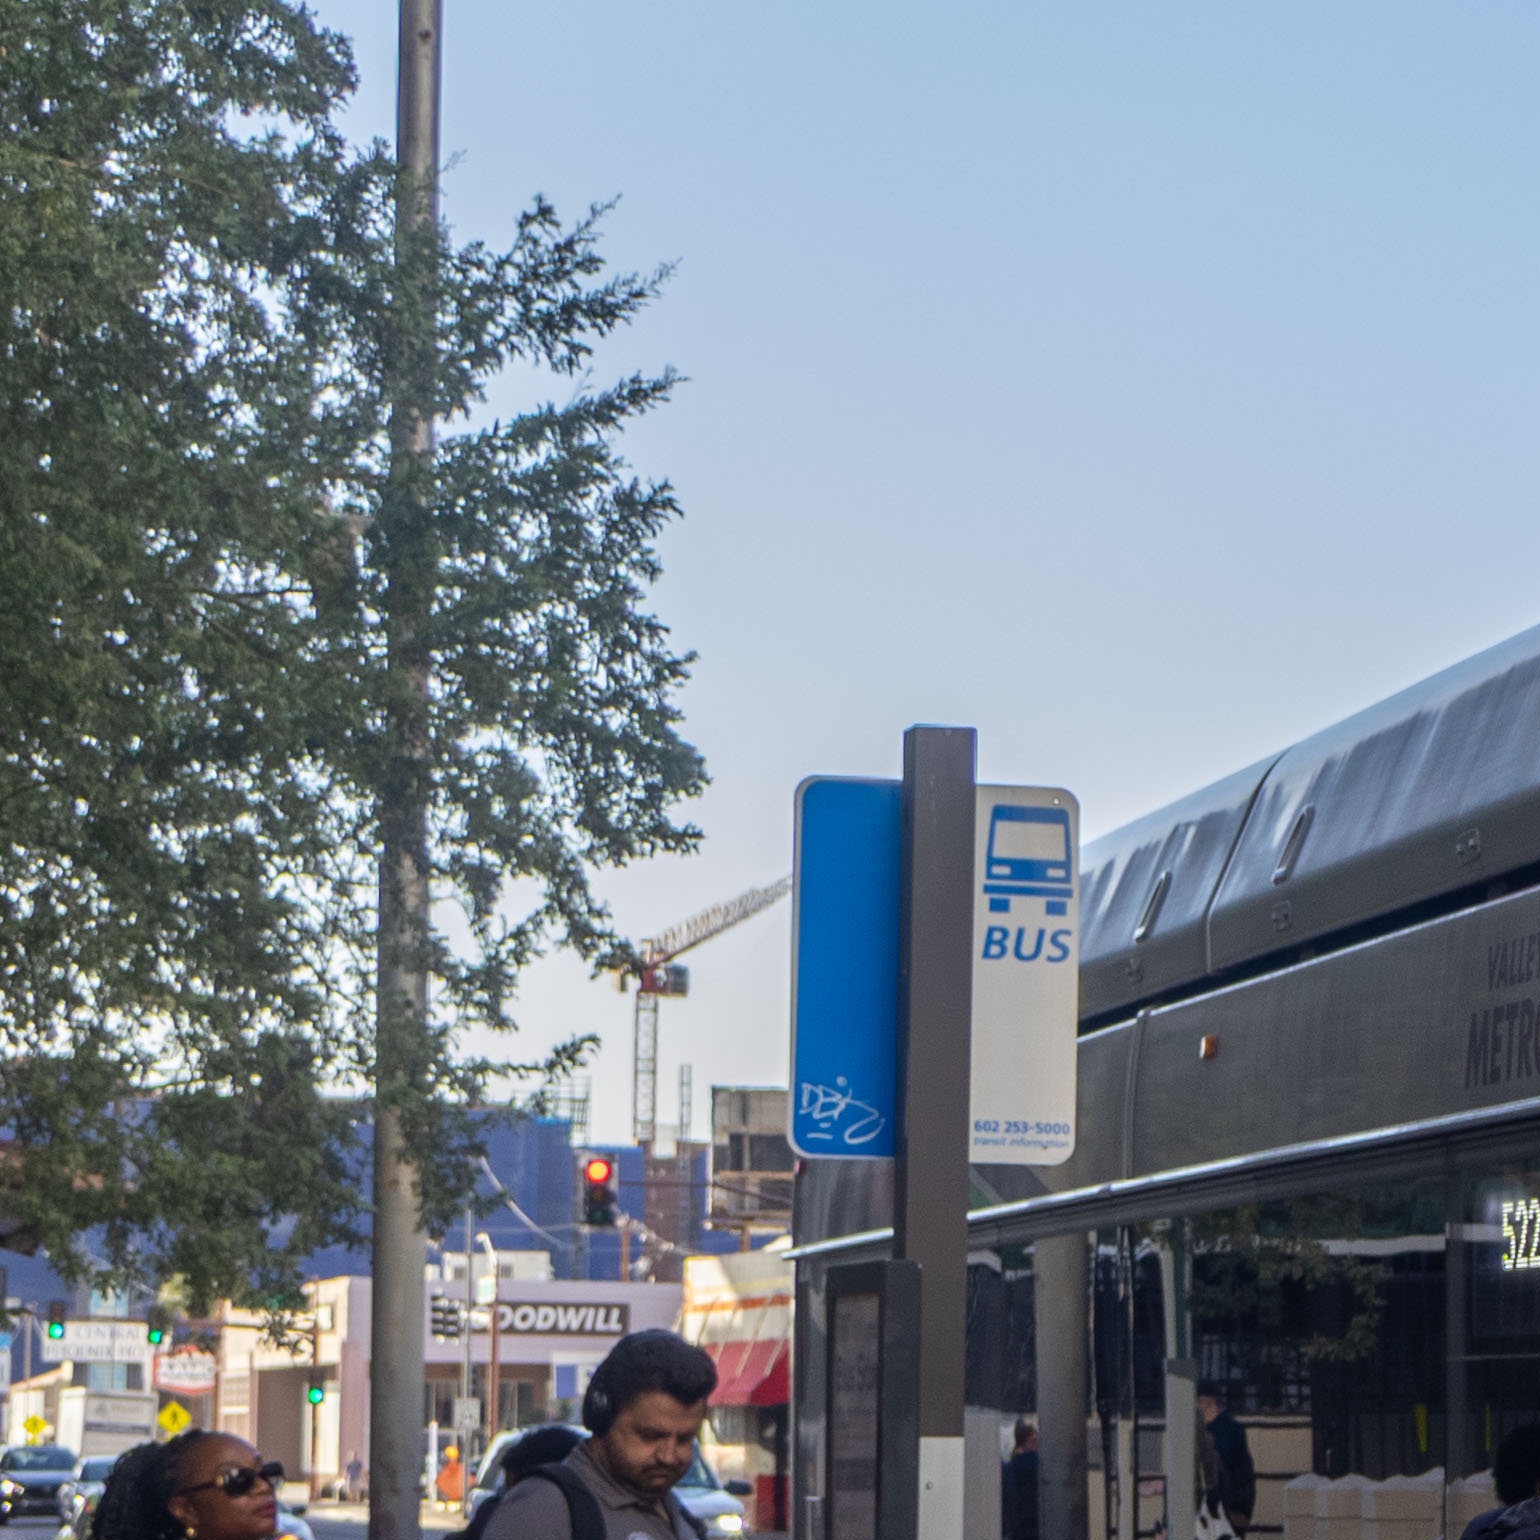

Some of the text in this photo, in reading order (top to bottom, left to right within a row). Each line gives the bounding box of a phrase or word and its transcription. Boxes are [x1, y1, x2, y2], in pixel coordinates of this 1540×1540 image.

[981, 926, 1072, 963] BUS
[973, 1120, 1071, 1135] 602 253-5000
